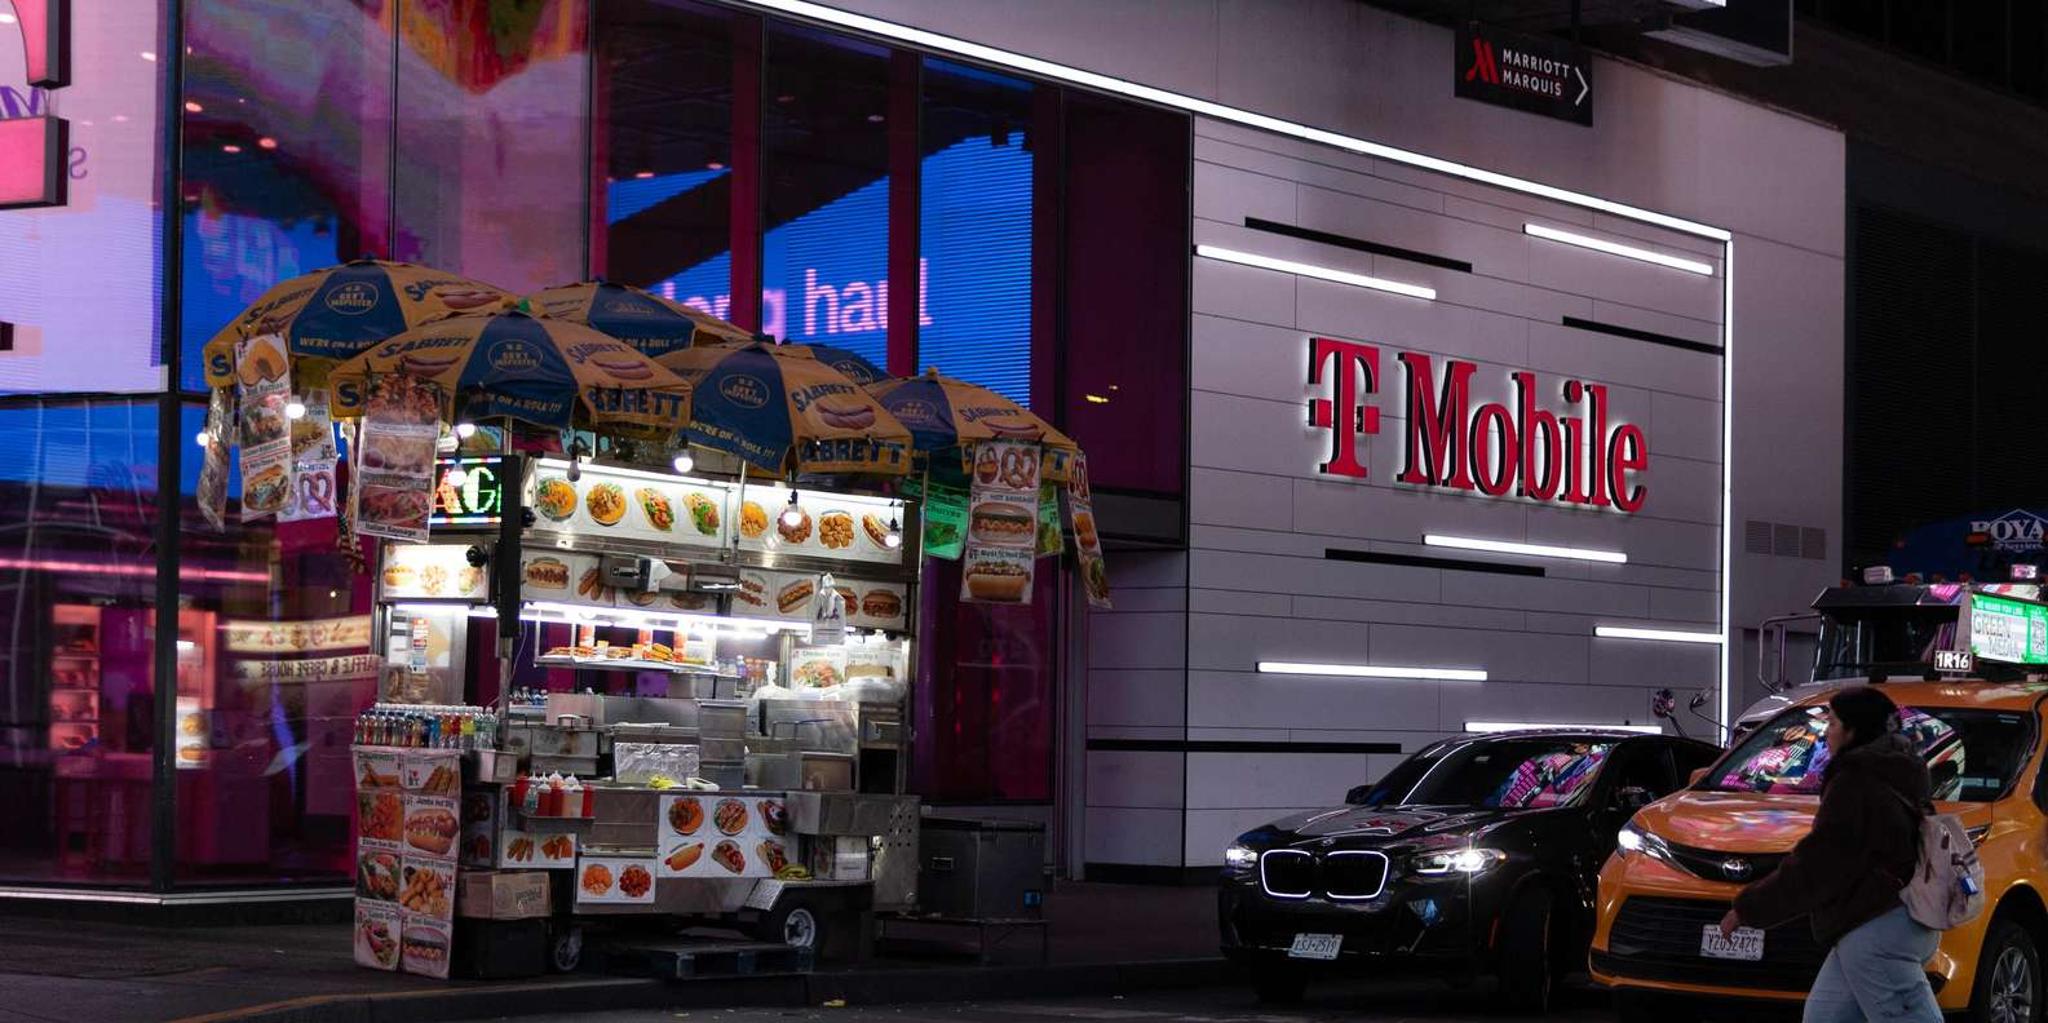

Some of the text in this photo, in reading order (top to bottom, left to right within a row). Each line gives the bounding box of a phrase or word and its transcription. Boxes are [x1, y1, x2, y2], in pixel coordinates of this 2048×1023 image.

[1503, 48, 1570, 79] MARRIOTT
[1503, 69, 1562, 97] MARQUIS
[791, 384, 856, 412] SABRETT
[1397, 352, 1648, 512] Mobile
[1935, 653, 1970, 670] 1R16
